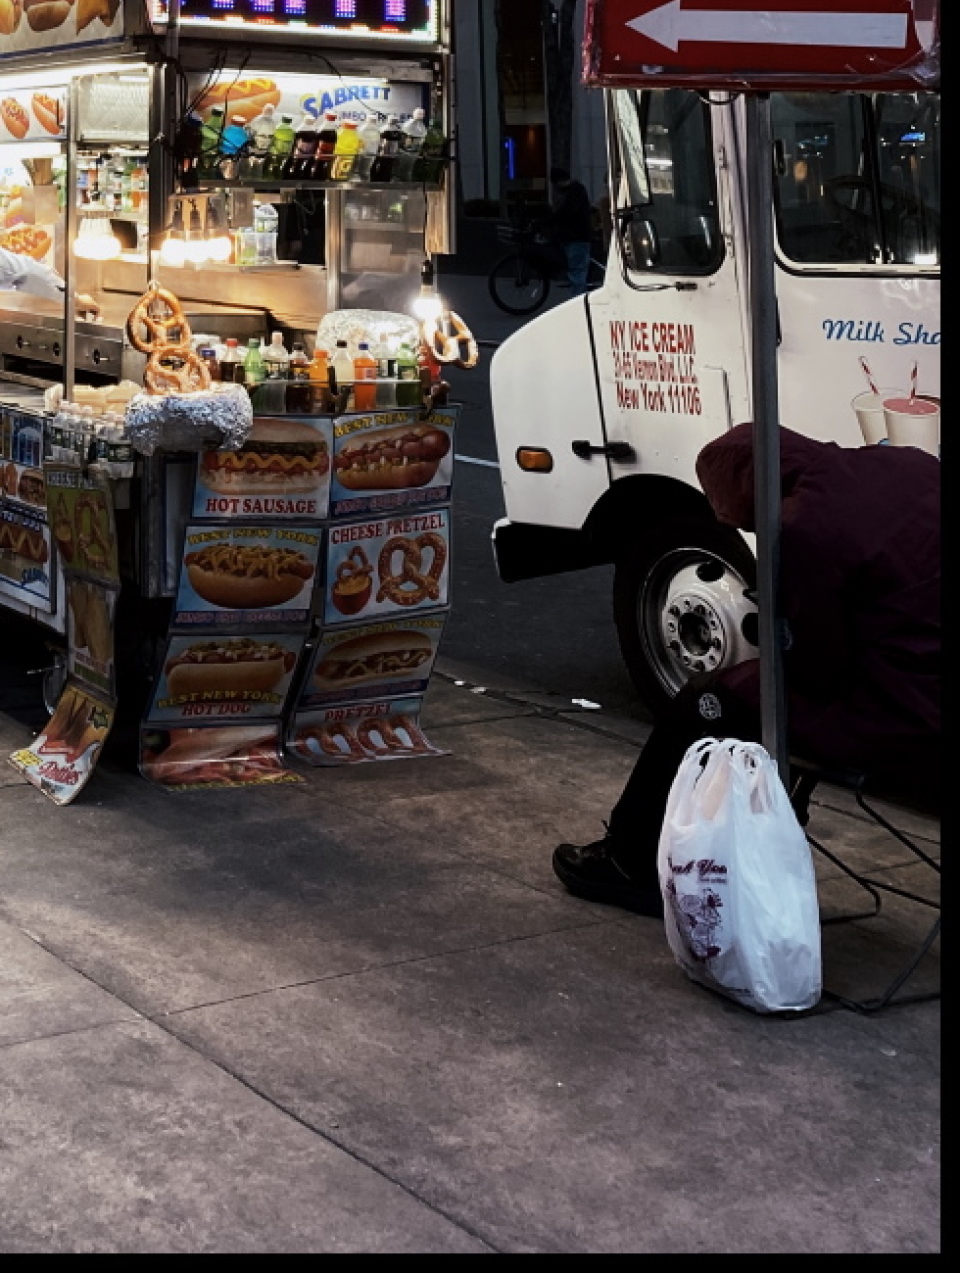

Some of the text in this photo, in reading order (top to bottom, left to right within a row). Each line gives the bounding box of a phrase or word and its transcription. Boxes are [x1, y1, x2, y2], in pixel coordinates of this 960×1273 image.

[302, 85, 391, 119] SABRETT
[609, 321, 696, 355] NY ICE CREAM
[822, 319, 885, 343] Milk
[616, 380, 640, 410] New
[640, 382, 667, 413] York
[205, 497, 238, 513] HOT
[242, 498, 318, 514] SAUSAGE
[187, 530, 231, 545] BEST
[233, 528, 272, 538] NEW
[332, 513, 446, 544] CHEESE PRETZEL
[202, 690, 239, 701] NEW
[242, 690, 283, 704] YORK
[181, 703, 252, 717] HOT DOG
